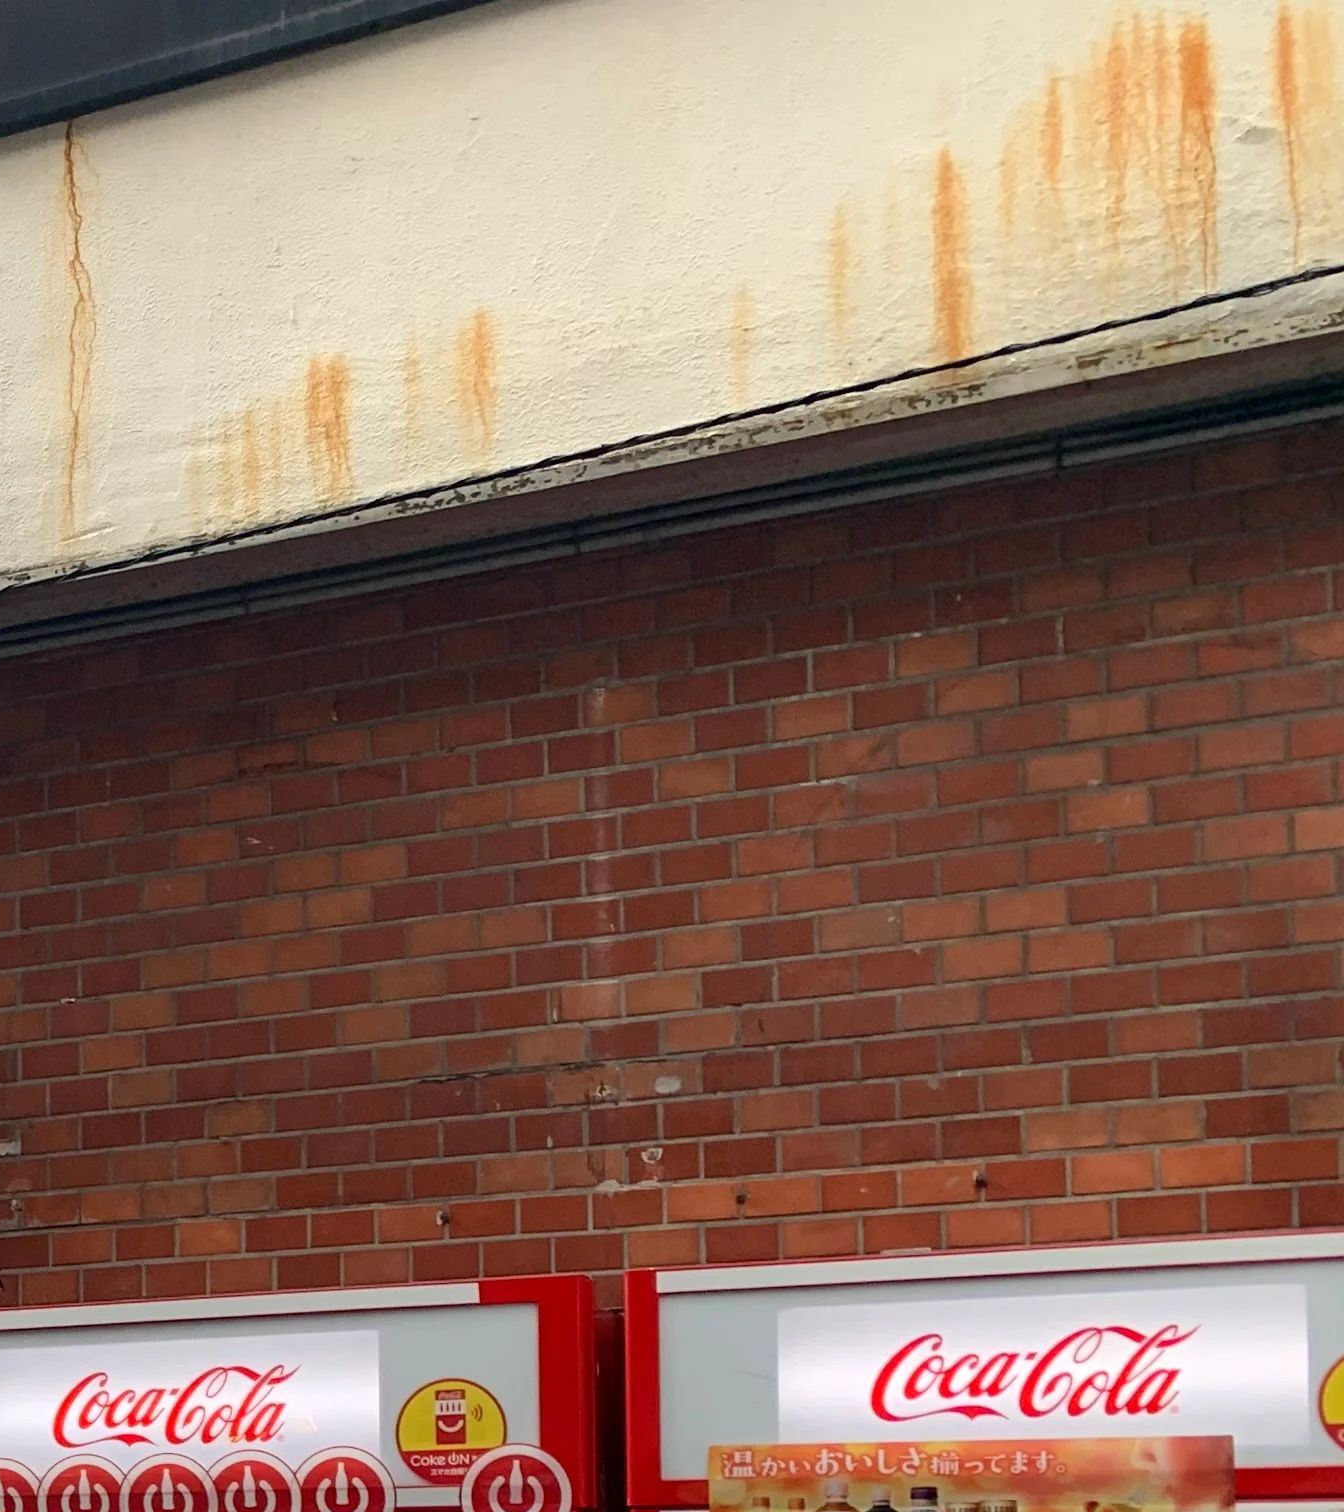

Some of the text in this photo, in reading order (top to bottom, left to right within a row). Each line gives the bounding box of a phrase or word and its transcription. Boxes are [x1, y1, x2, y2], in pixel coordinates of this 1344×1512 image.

[870, 1323, 1200, 1422] Coca-Cola
[52, 1364, 301, 1448] Coca-Cola
[410, 1454, 446, 1467] Coke
[722, 1447, 1068, 1479] 温かいおいしさ揃ってます。
